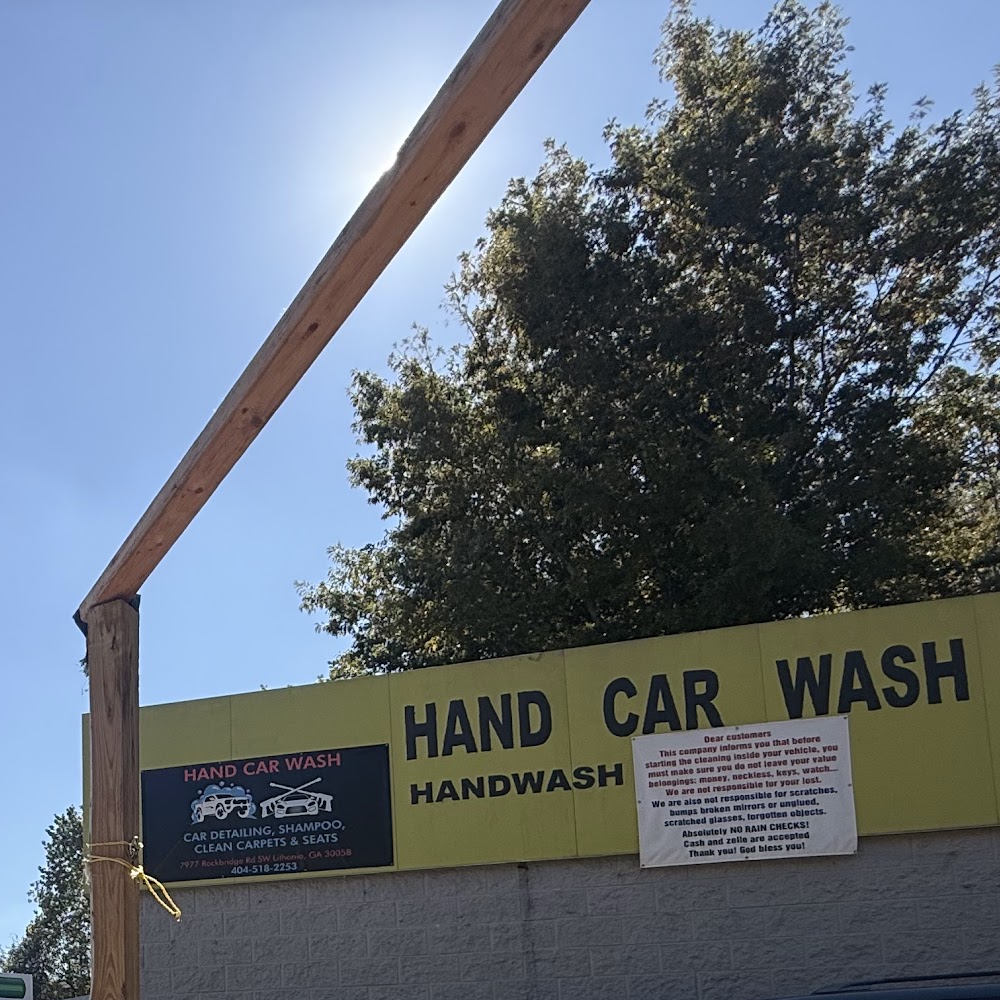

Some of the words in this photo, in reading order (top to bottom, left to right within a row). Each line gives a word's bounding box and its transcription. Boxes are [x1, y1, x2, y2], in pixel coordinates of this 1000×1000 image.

[404, 690, 552, 760] HAND
[602, 669, 724, 737] CAR
[776, 639, 970, 720] WASH
[679, 746, 717, 756] company
[720, 742, 752, 752] informs
[754, 741, 771, 749] you
[772, 737, 790, 747] that
[792, 736, 821, 745] before
[704, 735, 724, 743] Dear
[726, 731, 772, 741] customers
[184, 764, 238, 782] HAND
[243, 759, 280, 776] CAR
[285, 752, 341, 771] WASH
[645, 760, 677, 769] starting
[679, 758, 692, 766] the
[694, 754, 731, 765] cleaning
[734, 751, 760, 760] inside
[762, 749, 782, 758] your
[648, 769, 669, 778] must
[670, 767, 694, 776] make
[696, 765, 715, 773] sure
[717, 763, 732, 772] you
[734, 762, 745, 770] do
[763, 759, 788, 767] leave
[790, 757, 810, 766] your
[812, 755, 837, 763] value
[410, 763, 624, 805] HANDWASH
[648, 777, 697, 788] belongings:
[665, 788, 679, 796] We
[697, 785, 711, 793] not
[712, 781, 764, 792] responsible
[765, 780, 778, 788] for
[780, 779, 801, 787] your
[704, 796, 718, 804] not
[720, 791, 773, 802] responsible
[774, 790, 788, 798] for
[664, 817, 707, 827] scratched
[747, 810, 788, 820] forgotten
[790, 808, 827, 817] objects.
[669, 809, 698, 817] bumps
[700, 805, 731, 814] broken
[733, 802, 766, 811] mirrors
[183, 832, 207, 843] CAR
[210, 825, 276, 840] DETAILING,
[278, 819, 346, 835] SHAMPOO,
[682, 828, 727, 838] Absolutely
[730, 826, 743, 834] NO
[745, 824, 767, 833] RAIN
[769, 821, 810, 831] CHECKS!
[194, 842, 233, 854] CLEAN
[236, 837, 287, 851] CARPETS
[290, 836, 299, 846] &
[302, 832, 339, 845] SEATS
[683, 839, 705, 848] Cash
[707, 838, 724, 846] and
[726, 836, 748, 844] zelle
[750, 835, 765, 843] are
[767, 832, 810, 841] accepted
[180, 860, 199, 869] 7977
[201, 857, 244, 867] Rockbridge
[245, 856, 256, 864] Rd
[257, 854, 271, 863] SW
[308, 850, 322, 859] GA
[689, 848, 715, 858] Thank
[717, 846, 737, 856] you!
[739, 845, 756, 854] God
[758, 843, 783, 852] bless
[785, 842, 805, 851] you!
[230, 861, 298, 875] 404-518-2253
